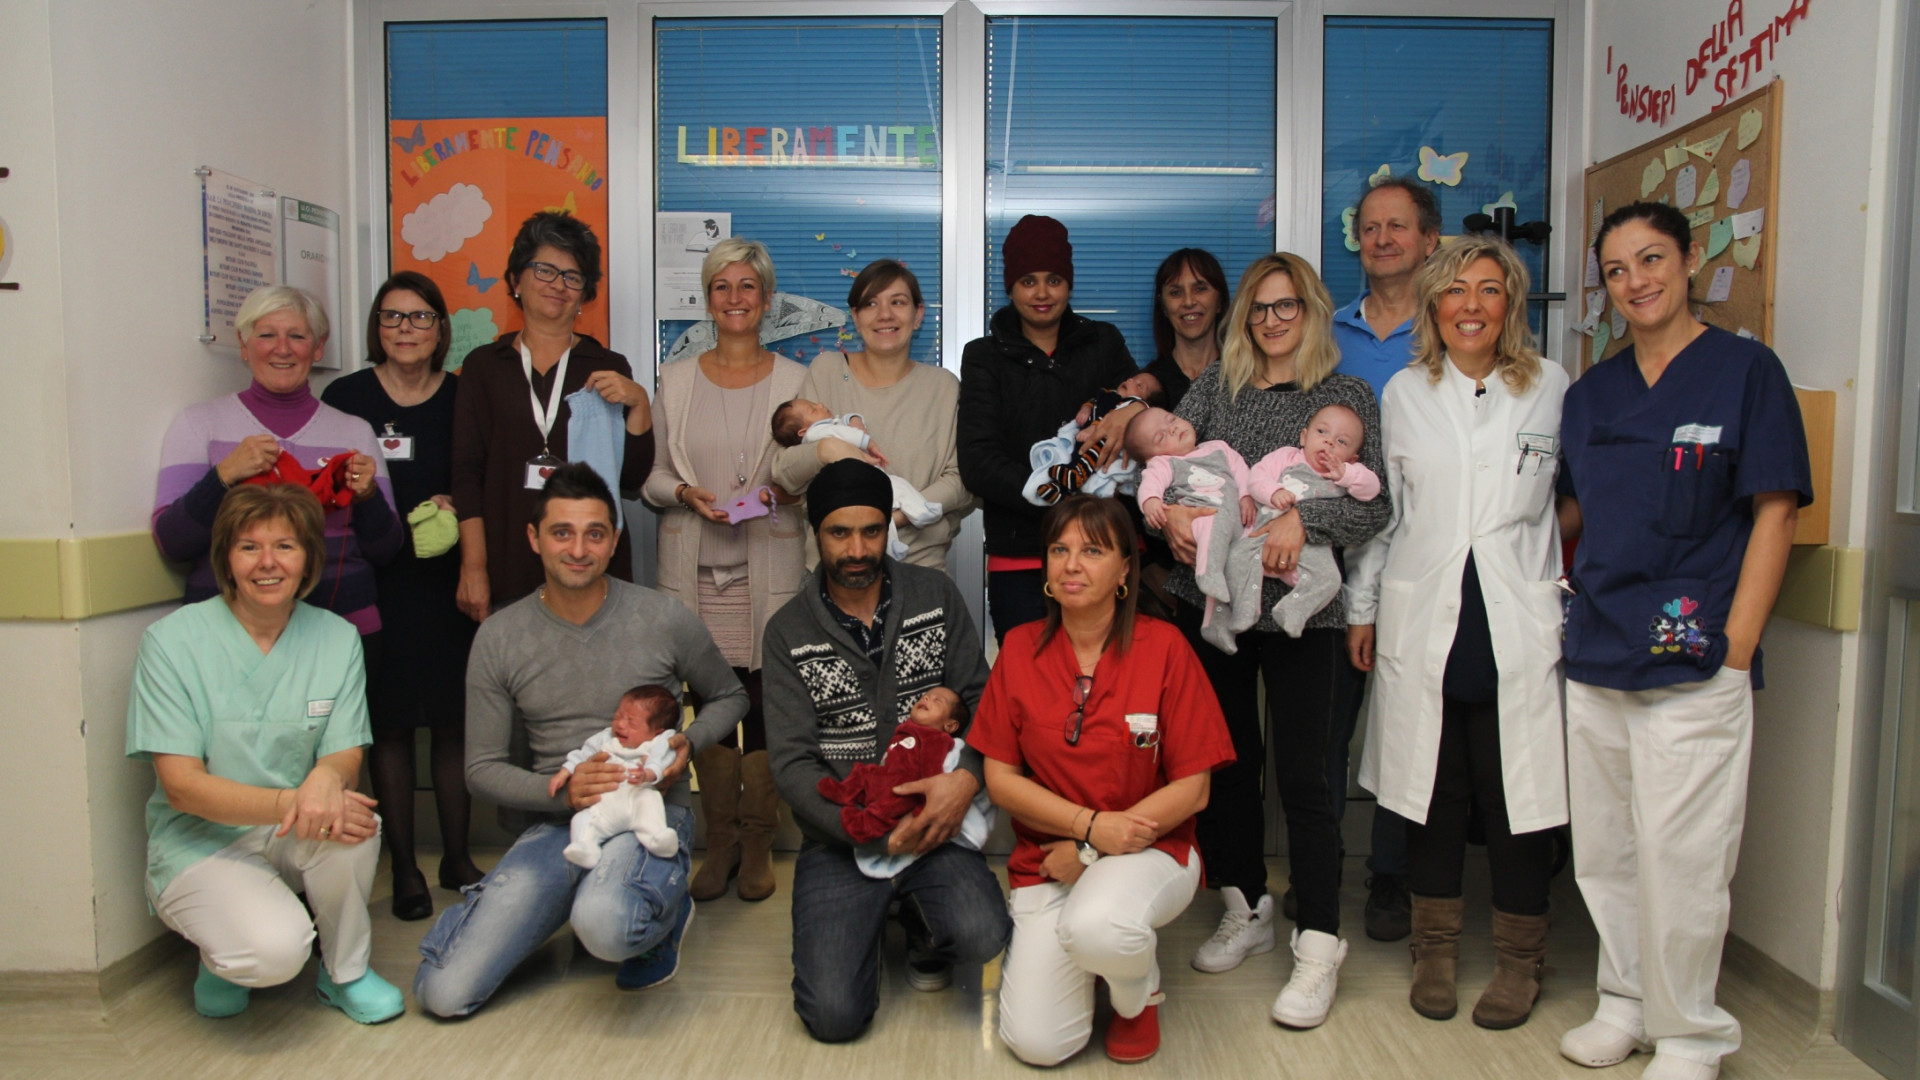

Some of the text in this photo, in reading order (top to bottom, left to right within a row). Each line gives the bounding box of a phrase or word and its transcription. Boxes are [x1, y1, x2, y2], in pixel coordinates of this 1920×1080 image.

[1685, 0, 1743, 96] DELLA
[400, 127, 604, 191] LIBERAMENTE PENSANDO
[677, 125, 938, 165] LIBERAMENTE
